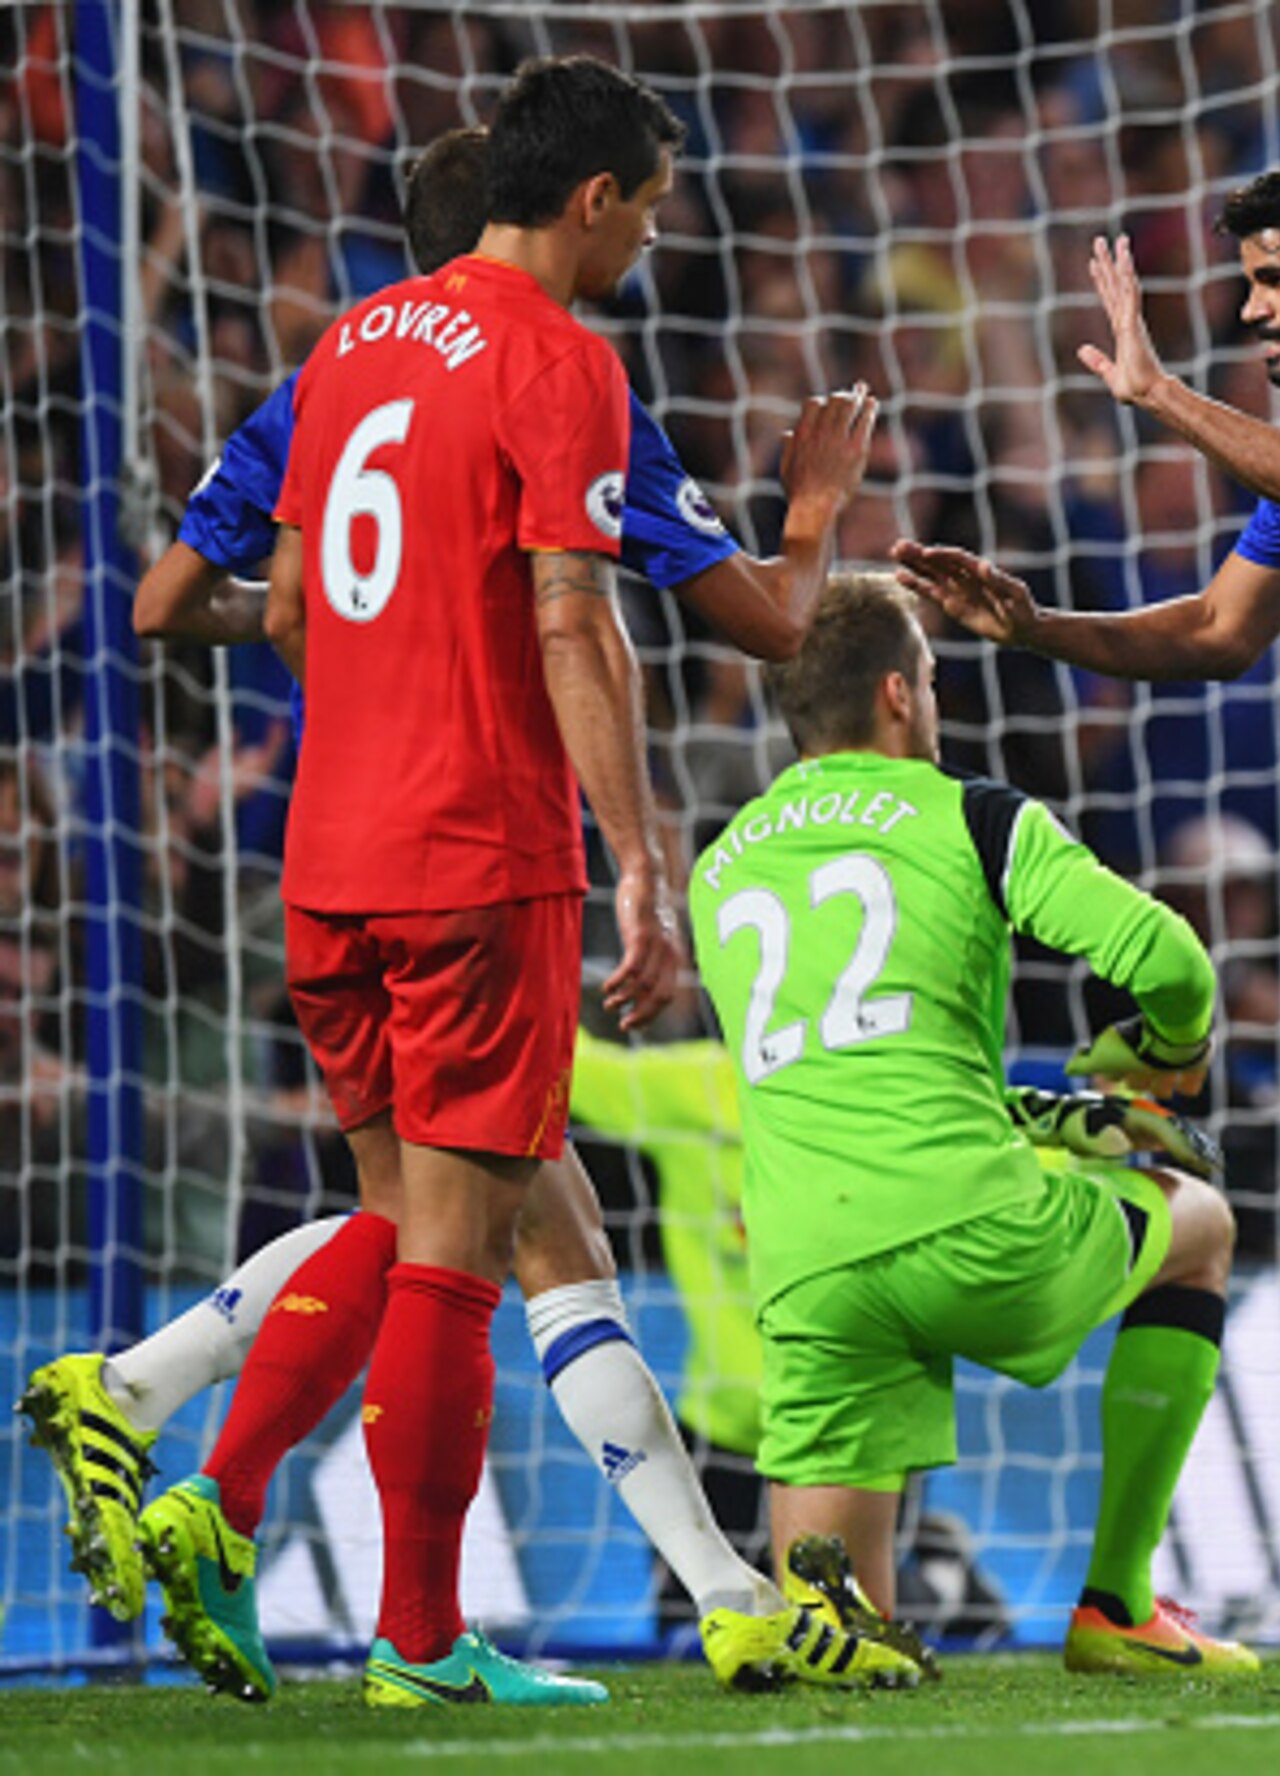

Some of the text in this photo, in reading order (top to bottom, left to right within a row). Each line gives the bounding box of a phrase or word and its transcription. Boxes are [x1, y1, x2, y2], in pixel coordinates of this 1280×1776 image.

[336, 300, 488, 372] LOVREN
[321, 398, 414, 622] 6
[703, 790, 918, 890] MIGNOLET
[716, 853, 913, 1086] 22
